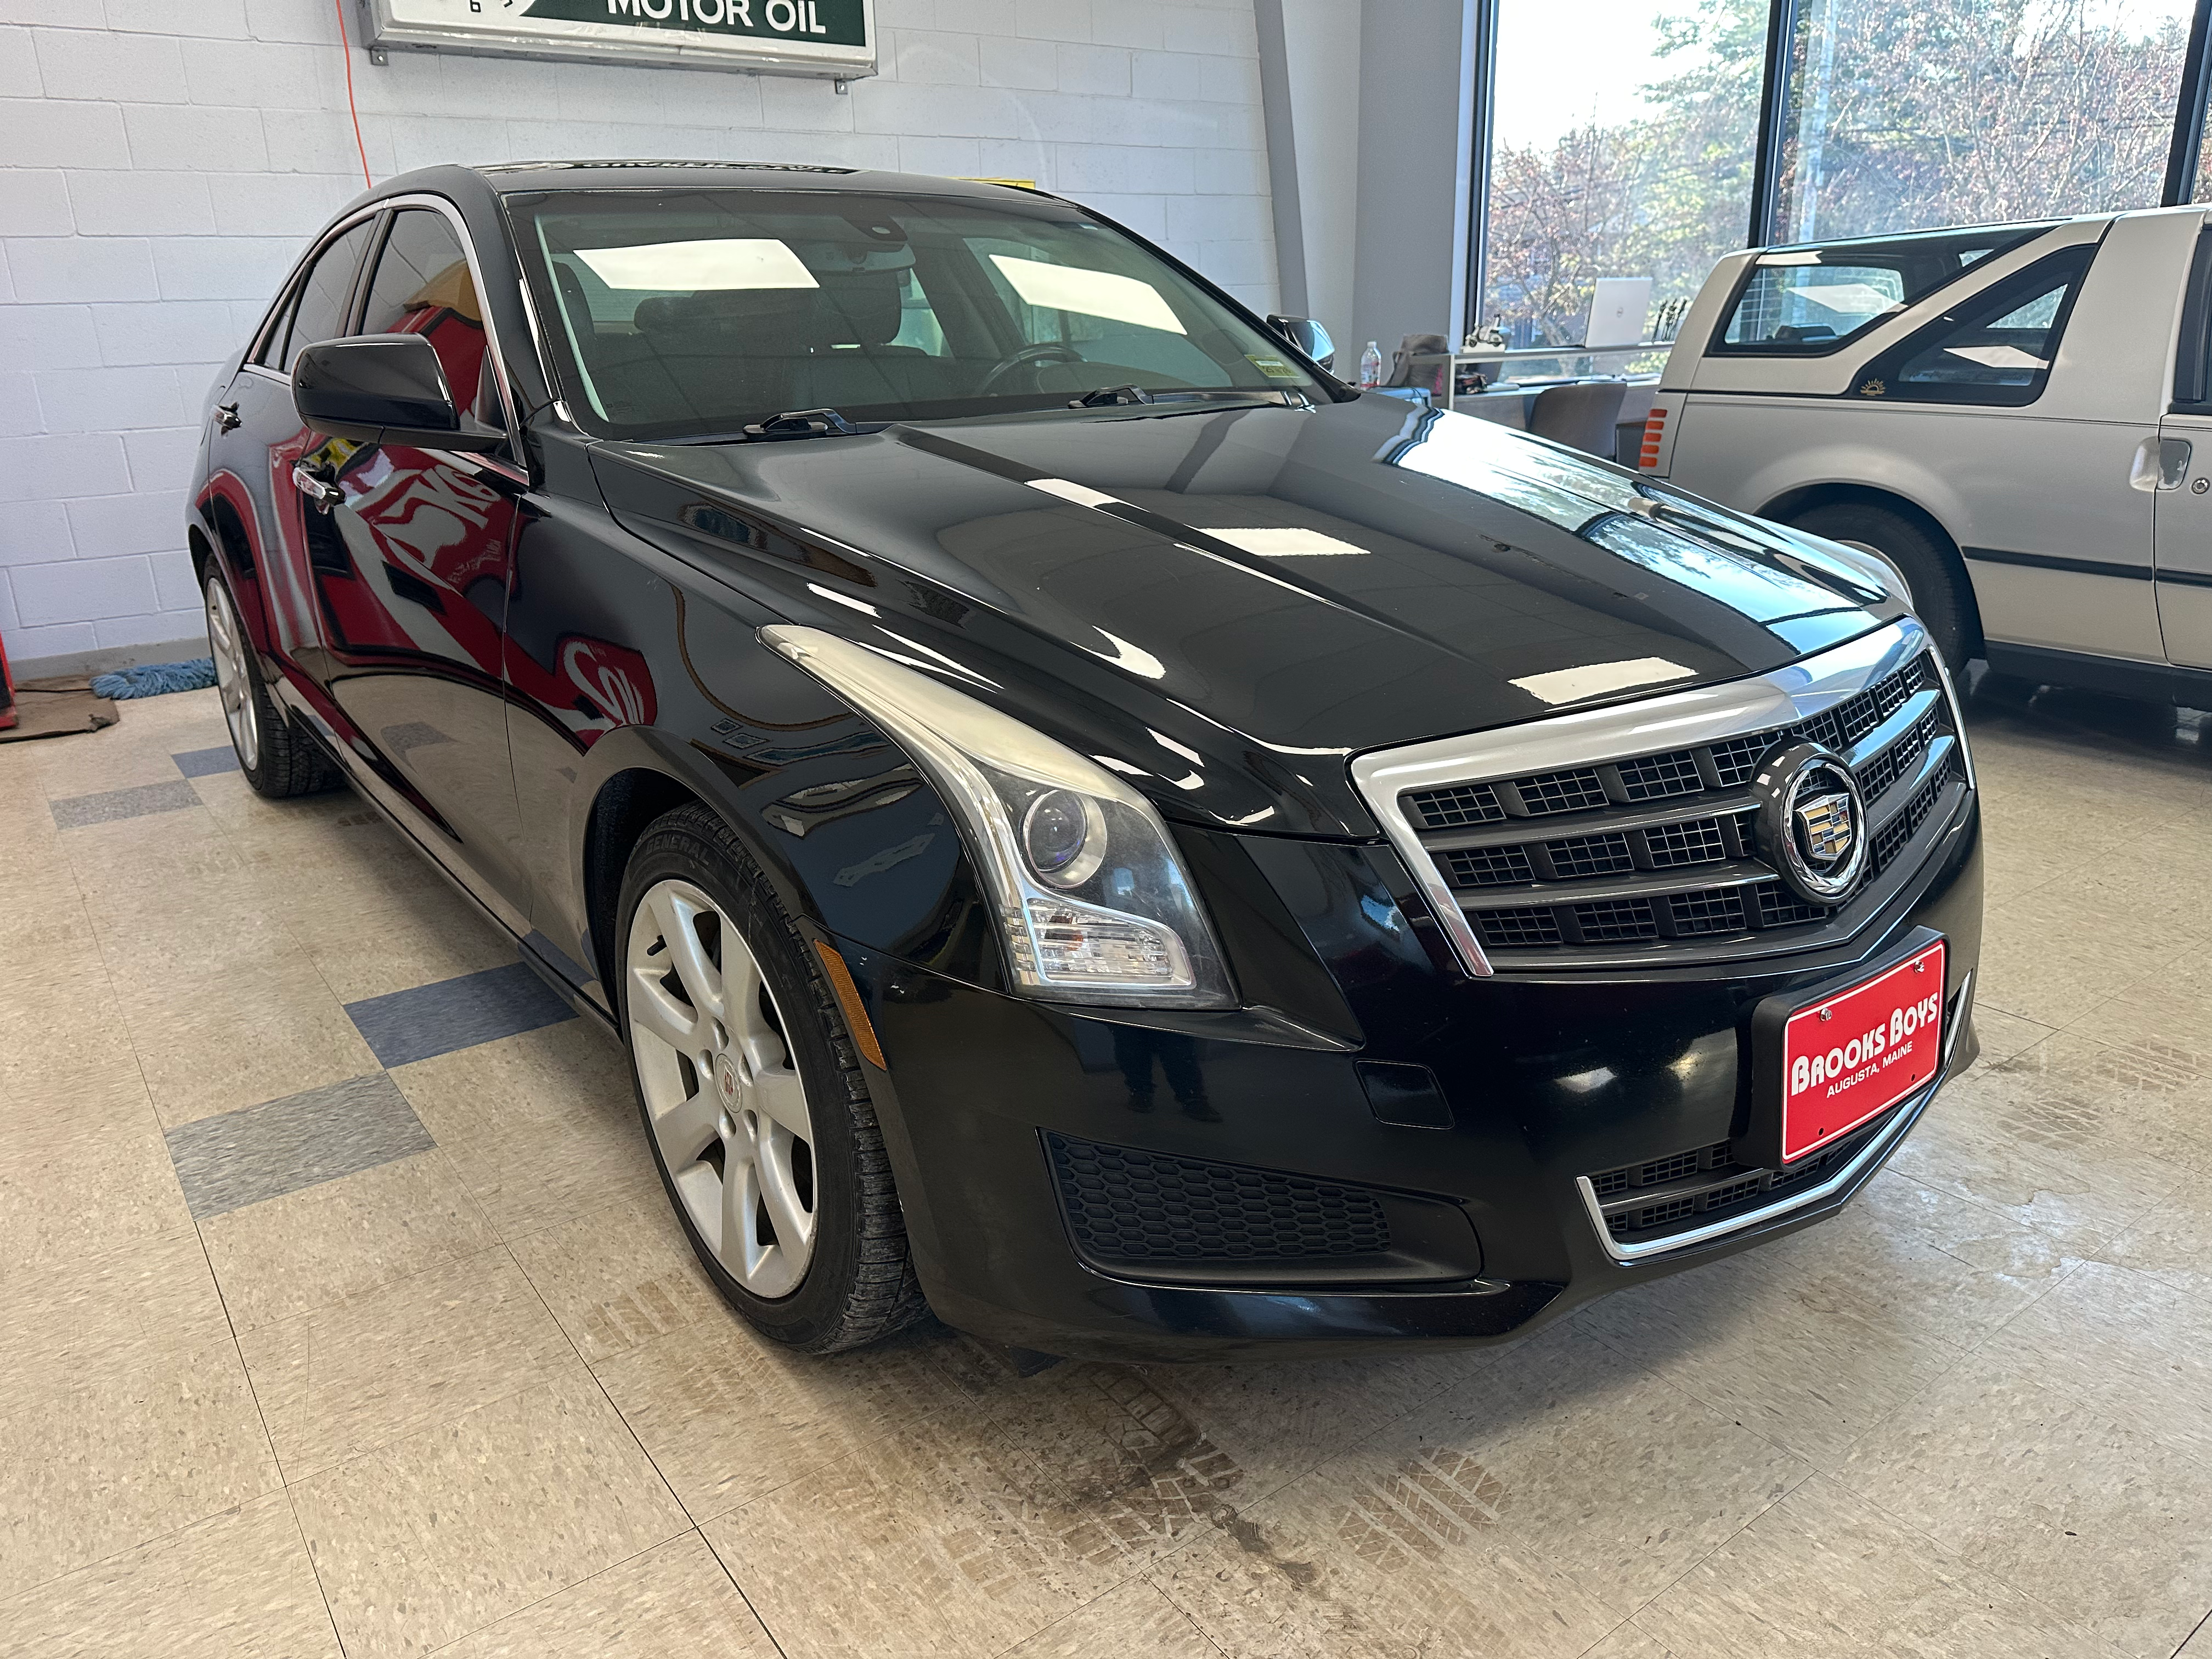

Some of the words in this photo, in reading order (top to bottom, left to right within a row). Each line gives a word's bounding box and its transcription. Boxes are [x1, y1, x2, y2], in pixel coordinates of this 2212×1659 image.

[765, 0, 826, 33] OIL
[645, 833, 711, 866] GENERAL
[1791, 1023, 1886, 1097] BROOKS
[1889, 992, 1938, 1047] BOYS
[1826, 1065, 1880, 1098] AUGUSTA,
[1882, 1040, 1912, 1068] MAINE
